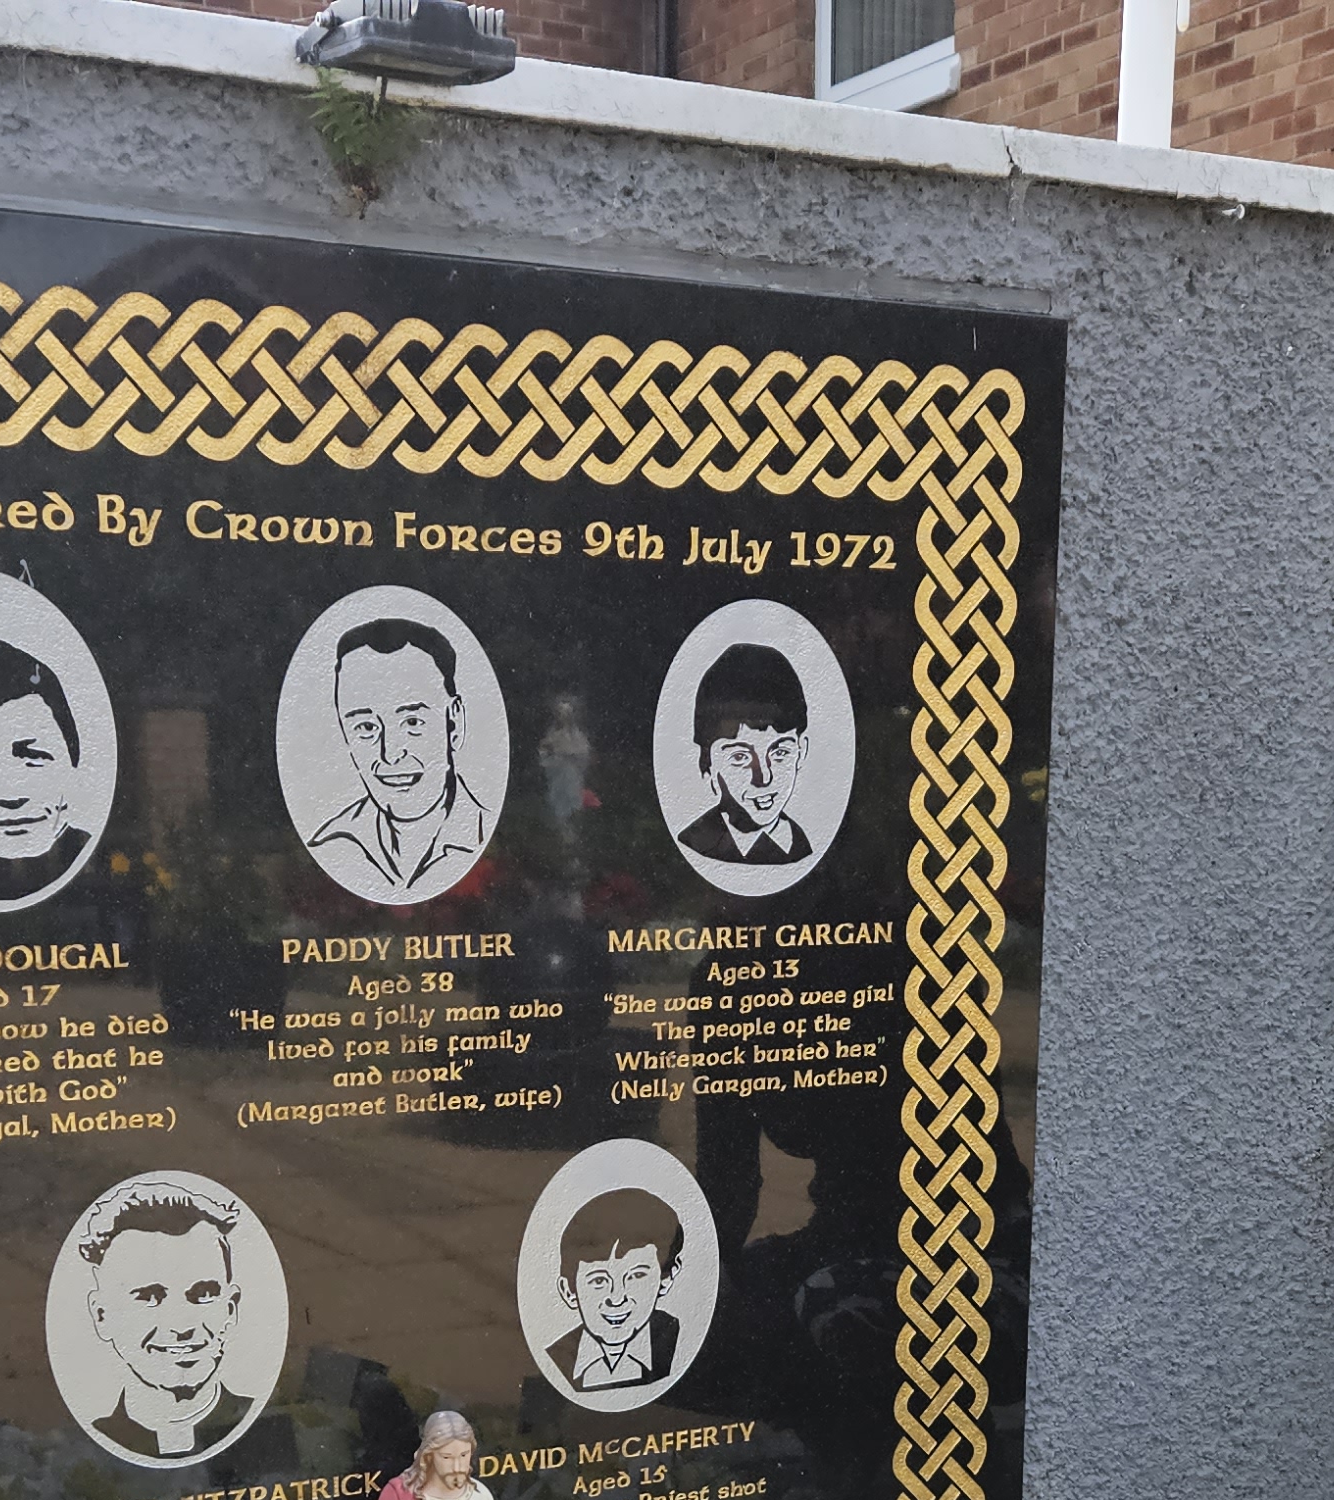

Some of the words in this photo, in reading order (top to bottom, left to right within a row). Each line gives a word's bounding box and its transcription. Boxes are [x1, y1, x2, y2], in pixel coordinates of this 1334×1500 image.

[96, 493, 163, 547] By
[185, 499, 374, 547] Crown
[394, 511, 562, 556] Forces
[582, 521, 665, 560] 9th
[682, 526, 773, 575] July
[790, 531, 897, 570] 1972
[282, 937, 392, 964] PADDY
[404, 932, 516, 960] BUTLER
[608, 925, 767, 953] MARGARET
[775, 921, 893, 947] GARGAN
[347, 974, 412, 1002] Aged
[420, 971, 454, 993] 38
[706, 960, 766, 987] Aged
[772, 958, 800, 979] 13
[21, 983, 61, 1007] 17
[671, 994, 712, 1013] was
[719, 995, 733, 1010] a
[739, 987, 795, 1015] good
[799, 989, 847, 1006] wee
[858, 984, 894, 1008] girl
[59, 1016, 96, 1038] he
[107, 1013, 169, 1037] died
[289, 1009, 343, 1028] was
[350, 1011, 366, 1027] a
[374, 1003, 436, 1031] jolly
[445, 1005, 501, 1022] man
[508, 998, 563, 1019] who
[651, 1020, 696, 1041] The
[702, 1017, 776, 1044] people
[782, 1018, 807, 1039] of
[813, 1013, 851, 1033] the
[51, 1048, 117, 1071] that
[128, 1045, 164, 1067] he
[268, 1037, 335, 1061] lived
[343, 1039, 391, 1063] for
[400, 1034, 439, 1054] his
[446, 1029, 532, 1058] family
[614, 1045, 746, 1072] Whiterock
[753, 1040, 830, 1064] buried
[332, 1065, 383, 1088] and
[610, 1078, 686, 1105] (Nelly
[691, 1075, 787, 1098] Gargan,
[793, 1064, 888, 1089] Mother)
[50, 1106, 177, 1134] Mother)
[237, 1096, 387, 1129] (Margaret
[394, 1091, 486, 1114] Butler,
[494, 1084, 562, 1112] wife)
[478, 1446, 567, 1478] DAVID
[572, 1470, 631, 1498] Aged
[640, 1464, 668, 1485] 15
[717, 1477, 767, 1500] shot
